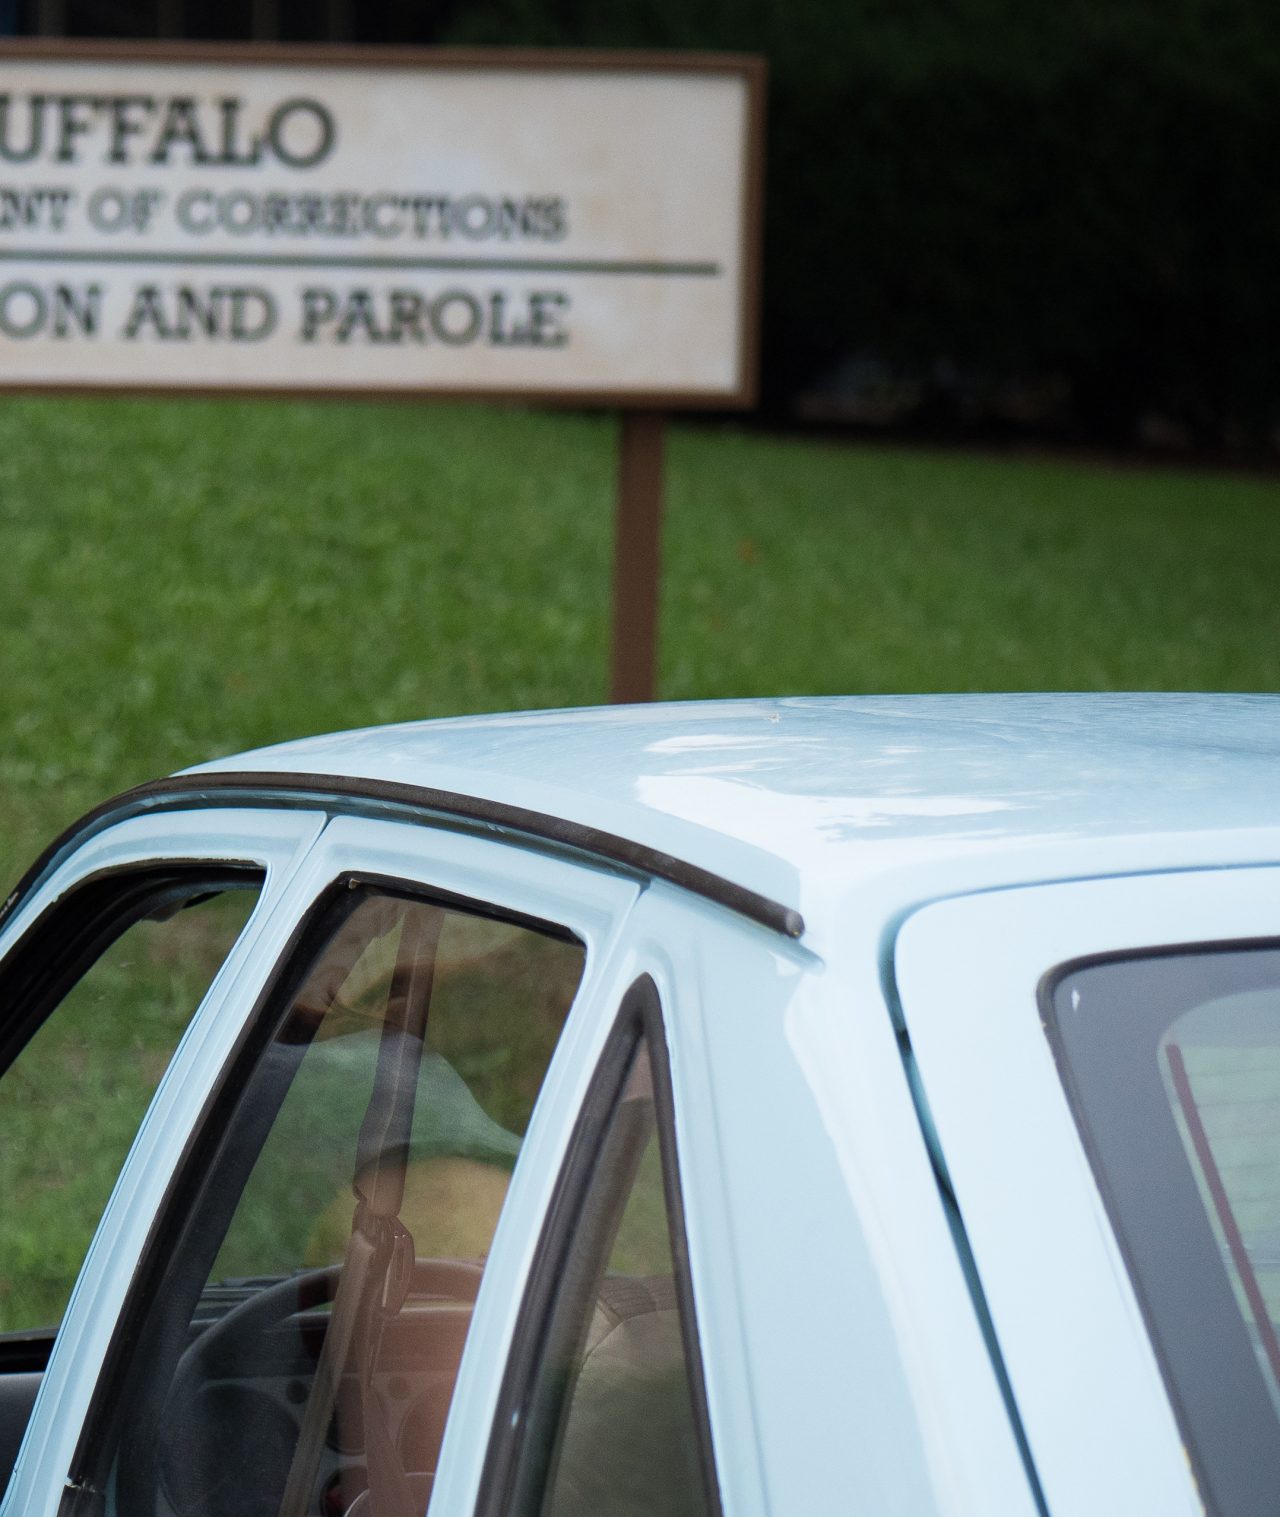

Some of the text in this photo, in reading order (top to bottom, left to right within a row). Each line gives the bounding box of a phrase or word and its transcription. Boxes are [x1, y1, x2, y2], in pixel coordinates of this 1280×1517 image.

[87, 190, 162, 234] OF
[175, 193, 568, 242] CORRECTIONS
[124, 285, 277, 342] AND
[299, 288, 570, 347] PAROLE
